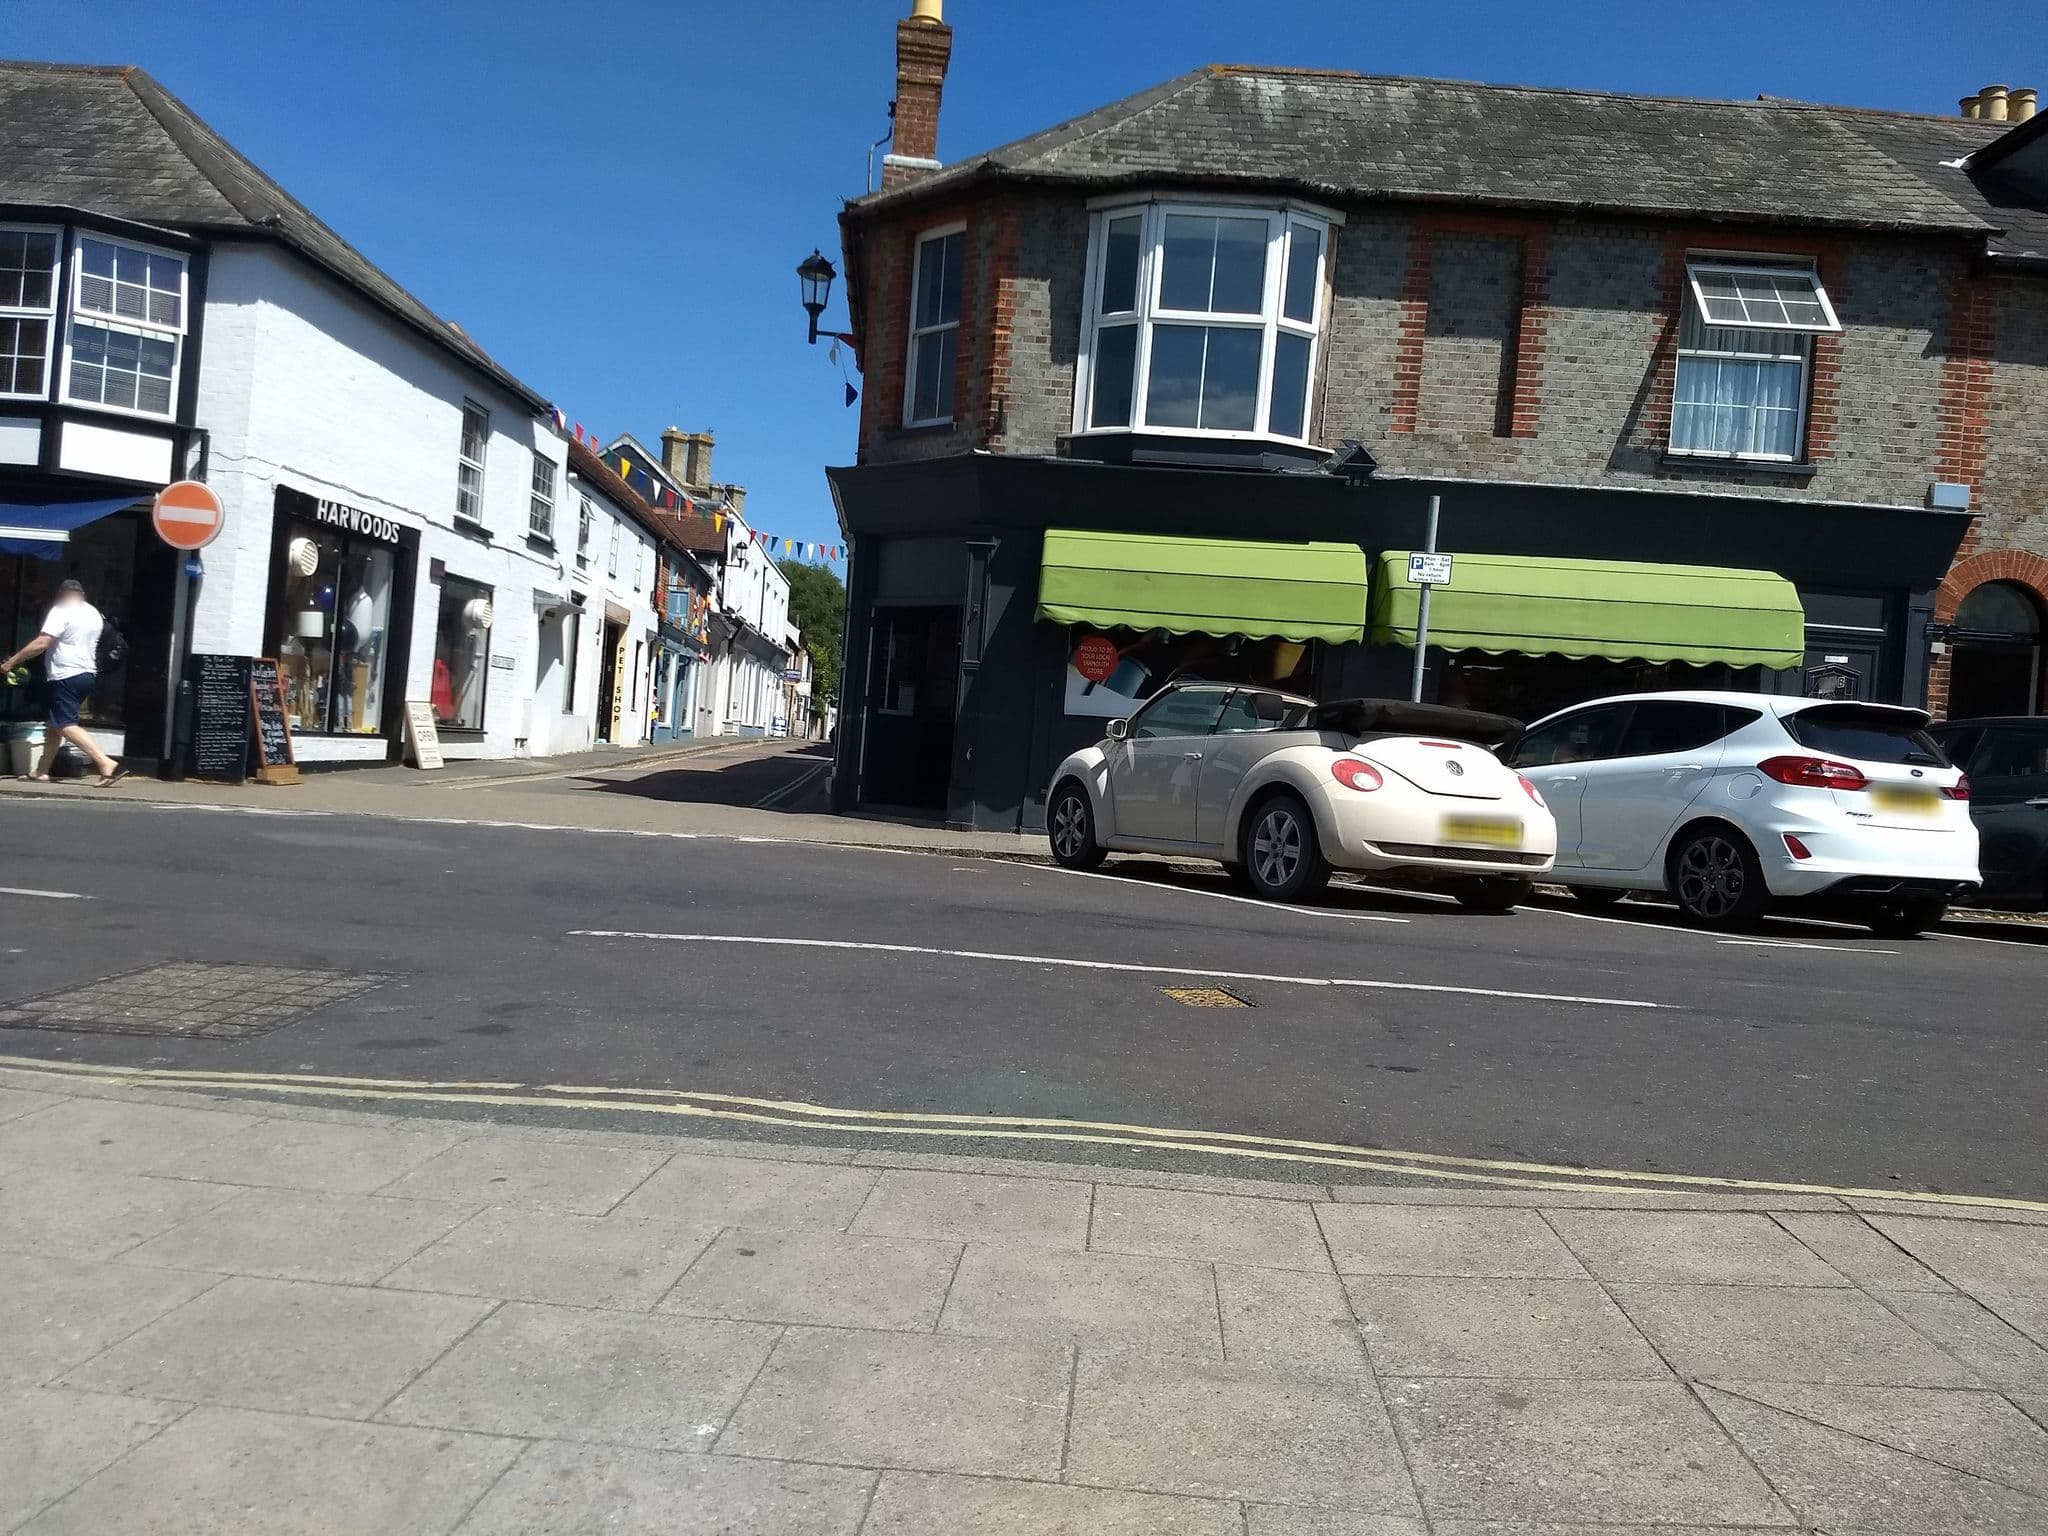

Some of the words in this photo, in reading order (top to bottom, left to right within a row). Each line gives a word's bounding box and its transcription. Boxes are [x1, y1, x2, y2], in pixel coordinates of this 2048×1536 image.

[317, 499, 400, 544] HARWOODS
[1080, 645, 1098, 653] PROUD
[1081, 652, 1096, 660] YOUR
[1096, 653, 1111, 661] LOCAL
[1087, 667, 1105, 675] STORE
[614, 686, 622, 723] SHOP
